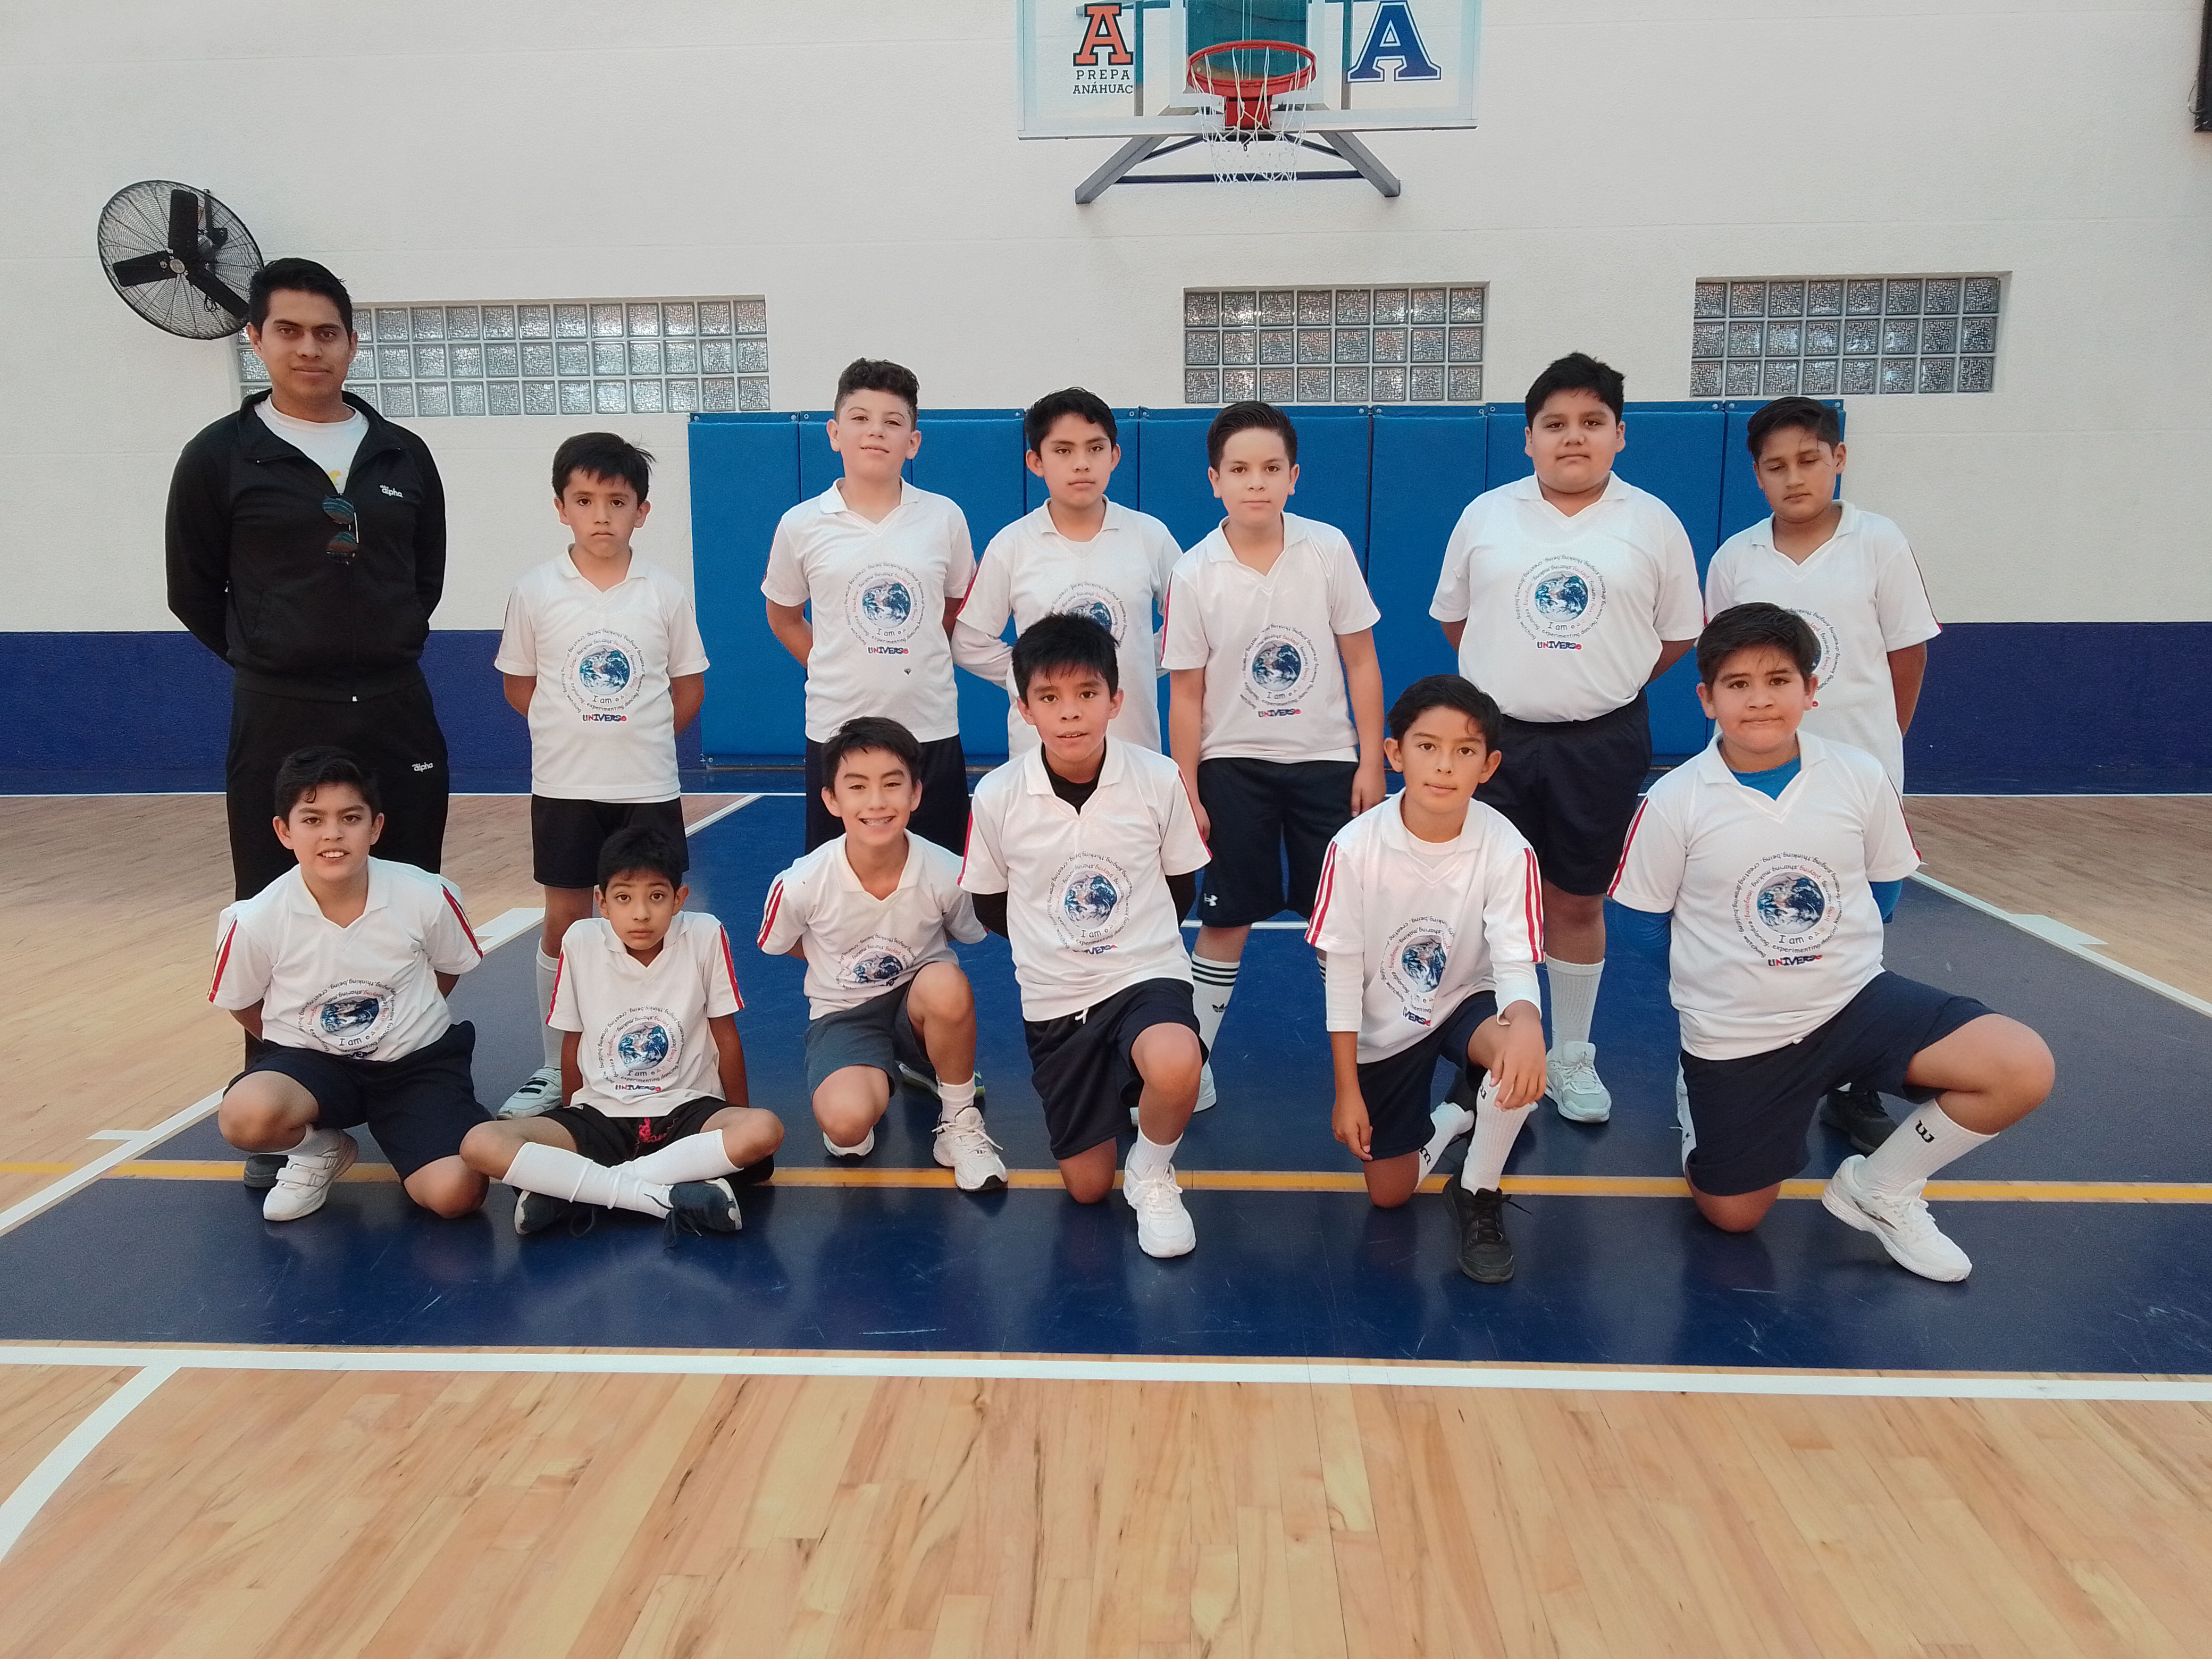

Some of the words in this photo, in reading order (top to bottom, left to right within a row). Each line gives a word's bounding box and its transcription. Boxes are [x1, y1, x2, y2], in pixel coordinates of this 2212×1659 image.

[1076, 69, 1130, 80] PREPA
[1073, 81, 1133, 94] ANÁHUAC
[1779, 934, 1786, 943] I
